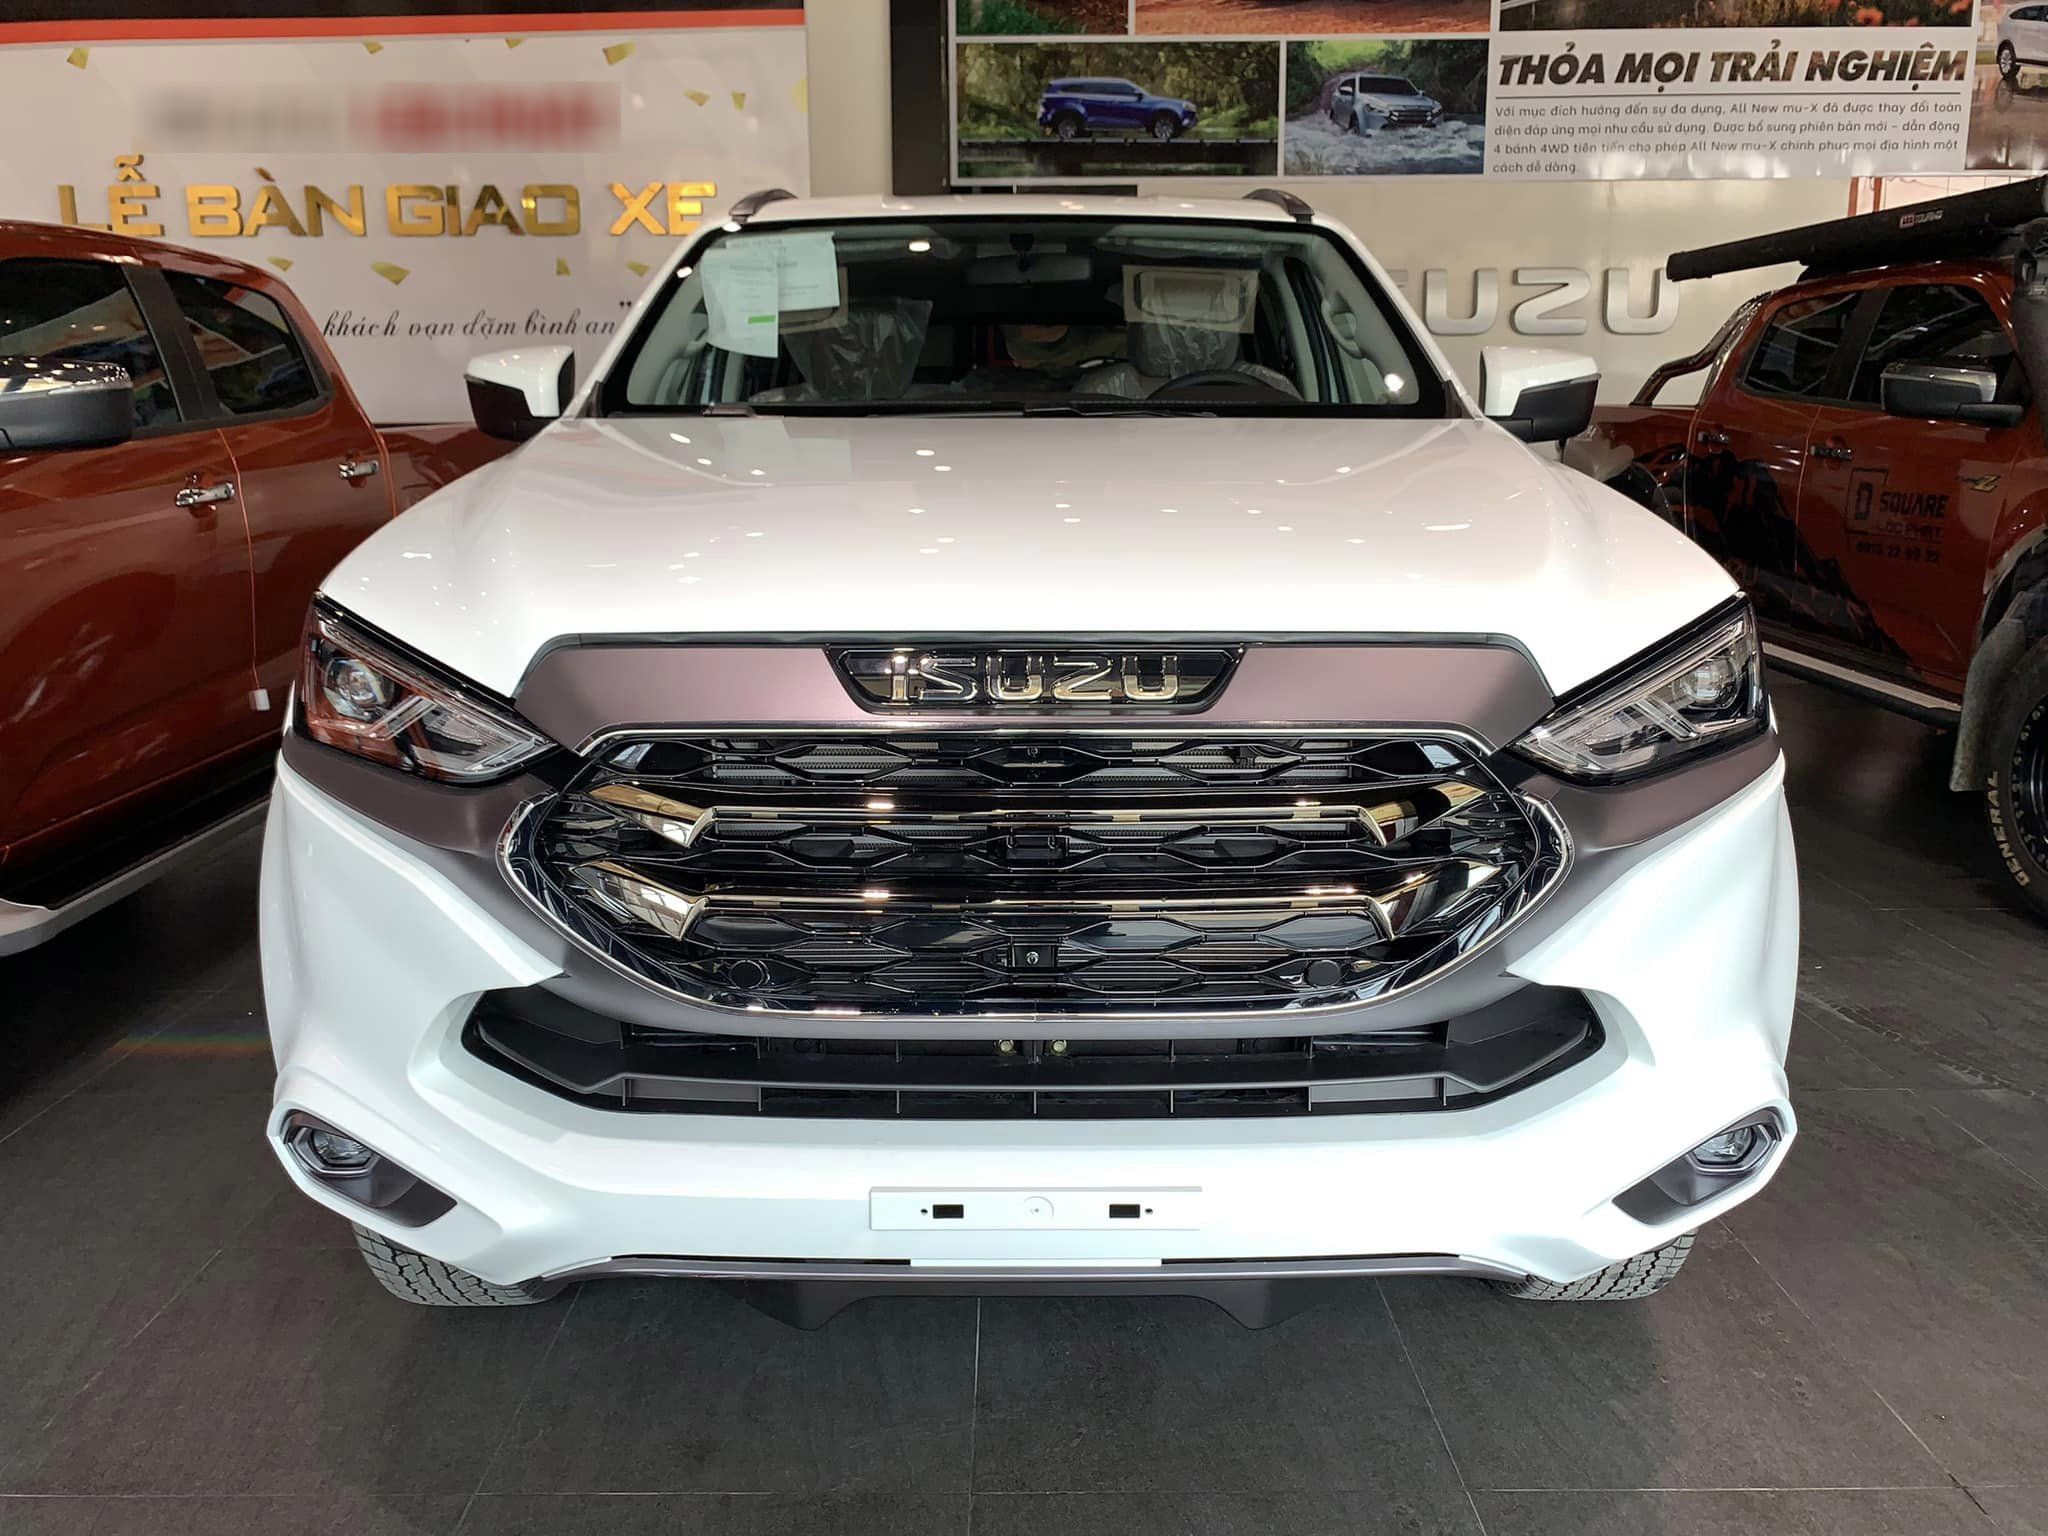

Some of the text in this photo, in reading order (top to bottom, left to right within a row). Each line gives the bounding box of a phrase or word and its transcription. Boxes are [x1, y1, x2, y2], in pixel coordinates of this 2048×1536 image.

[1499, 39, 1968, 93] THỎA MỌI TRẢI NGHIỆM
[1495, 105, 1515, 117] Với
[1519, 106, 1546, 120] mục
[1550, 105, 1577, 117] đích
[1730, 103, 1747, 114] All
[1752, 103, 1778, 114] New
[1783, 103, 1818, 114] mu-X
[1878, 101, 1906, 115] thay
[1934, 101, 1962, 113] toàn
[1578, 123, 1601, 137] mọi
[1767, 120, 1796, 134] sung
[1493, 144, 1501, 154] 4
[1540, 143, 1570, 154] 4WD
[1690, 141, 1706, 152] All
[1711, 141, 1737, 152] New
[1741, 140, 1776, 152] mu-X
[57, 153, 717, 237] LỄ BÀN GIAO XE
[1386, 268, 1681, 335] UZU
[323, 309, 400, 337] khách
[408, 321, 455, 340] vạn
[462, 309, 516, 340] dặm
[524, 308, 581, 336] bình
[1880, 491, 1950, 519] SQUARE
[890, 654, 1179, 704] ISUZU
[1987, 771, 2031, 887] GENERAL
